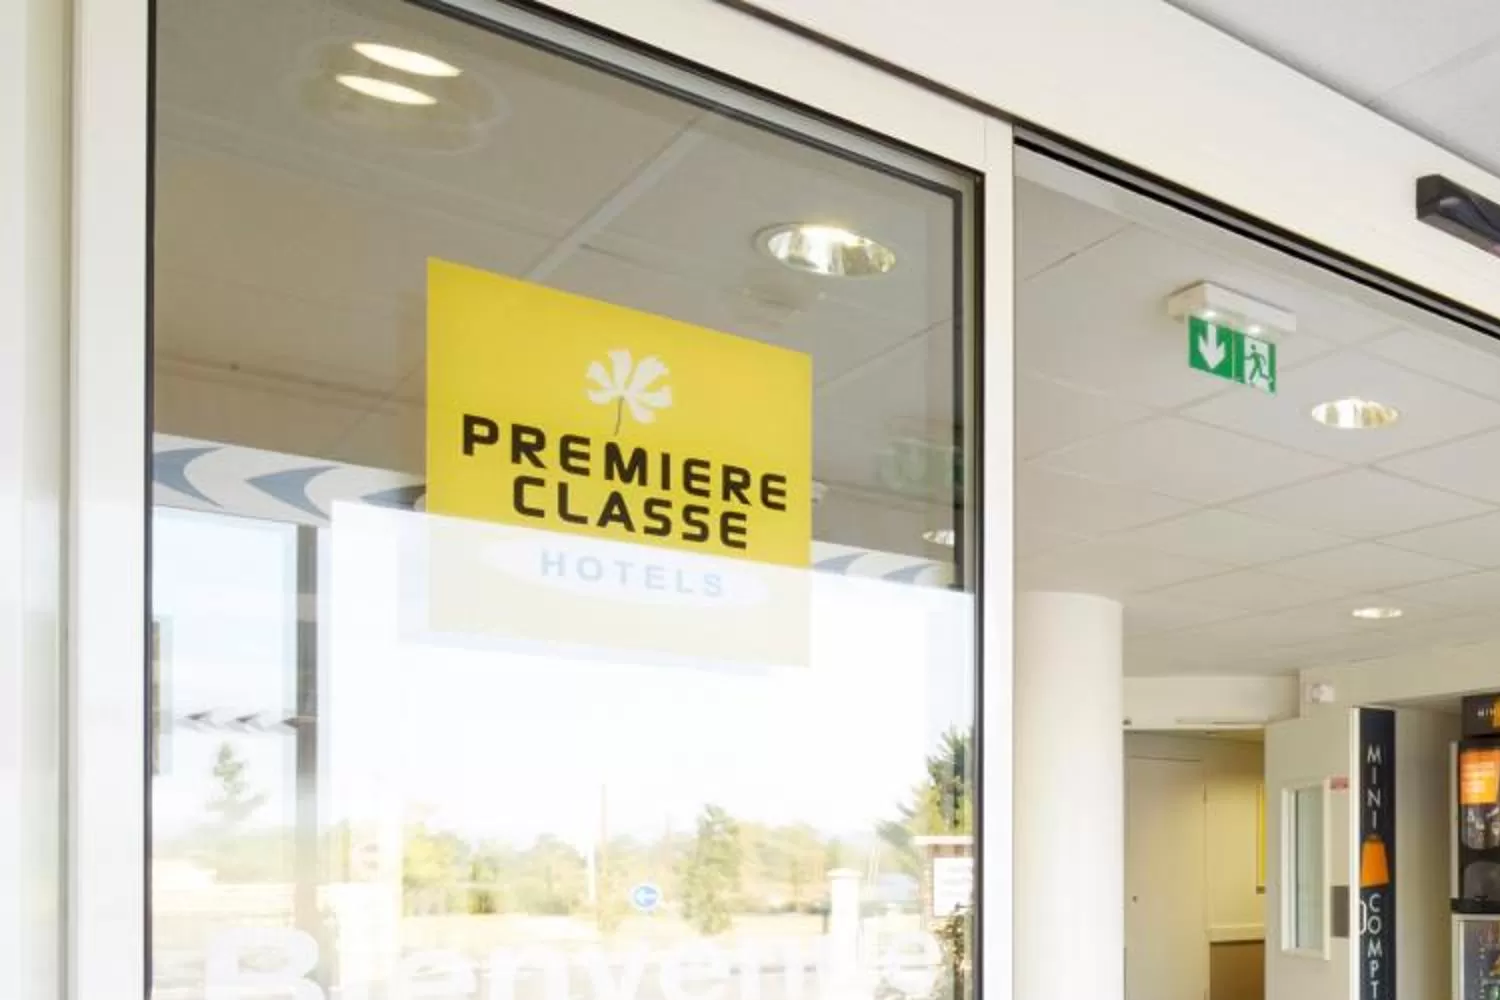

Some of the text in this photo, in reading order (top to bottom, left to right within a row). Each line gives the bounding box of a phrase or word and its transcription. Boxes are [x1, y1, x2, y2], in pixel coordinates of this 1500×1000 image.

[462, 413, 787, 512] PREMIERE
[512, 475, 747, 550] CLASSE
[540, 548, 724, 598] HOTELS
[1366, 745, 1382, 829] MINI
